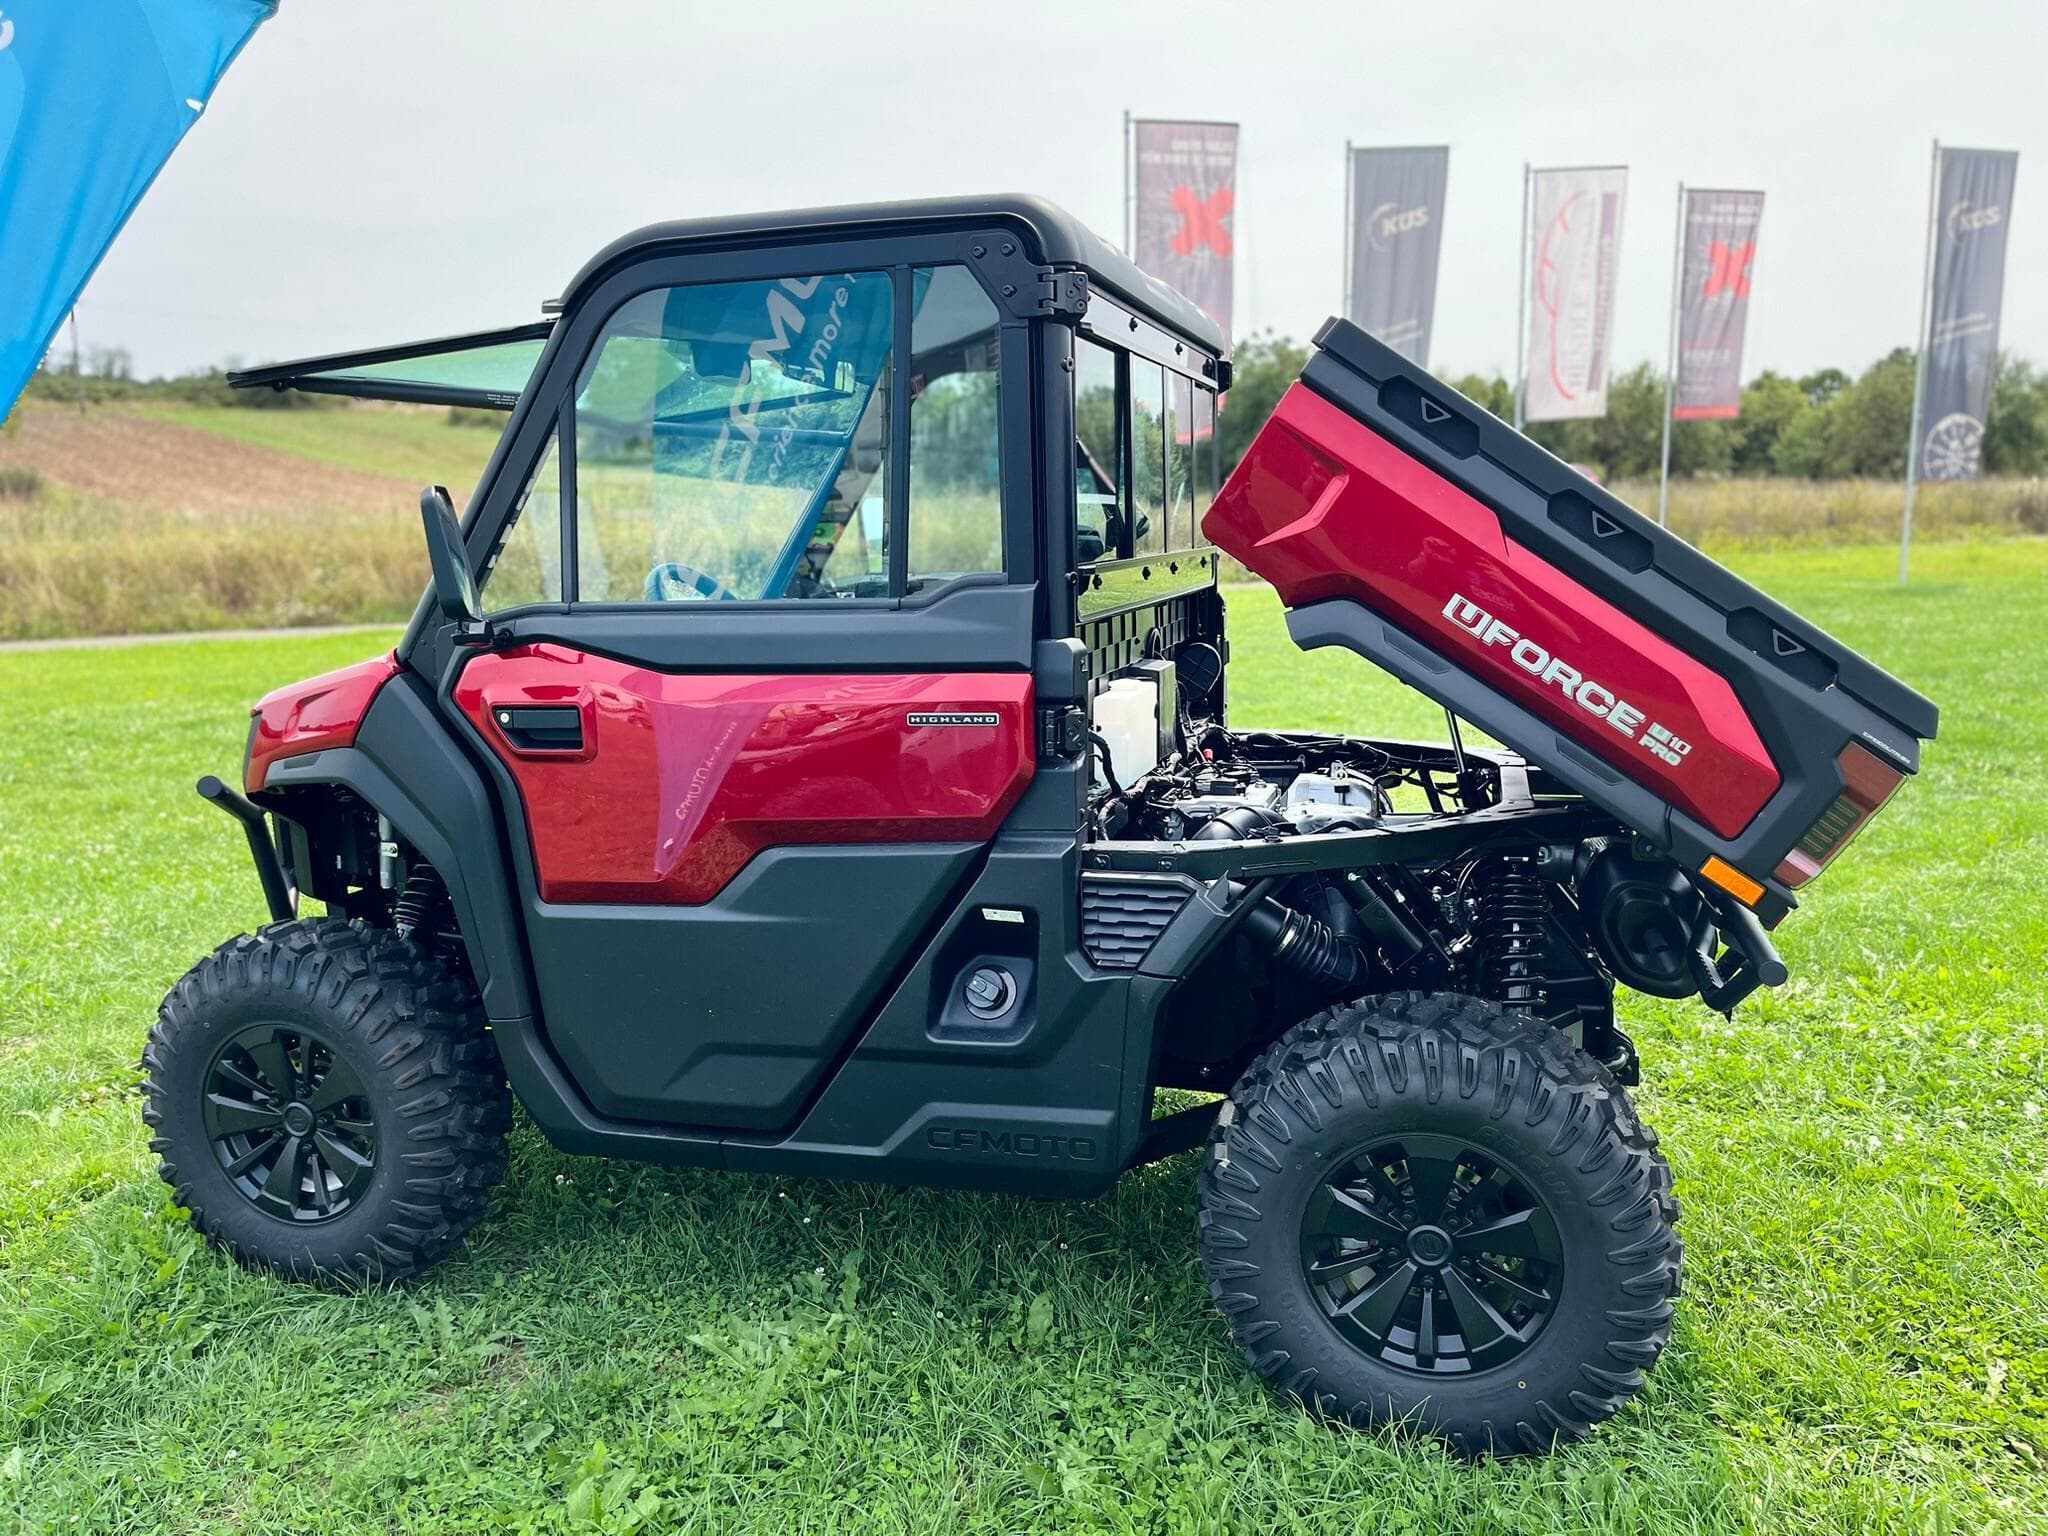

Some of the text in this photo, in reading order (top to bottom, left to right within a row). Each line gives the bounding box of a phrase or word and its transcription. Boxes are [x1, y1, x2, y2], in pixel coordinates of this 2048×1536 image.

[1442, 593, 1648, 739] UFORCE
[1638, 736, 1682, 766] PRO
[927, 1127, 1097, 1160] CFMOTO
